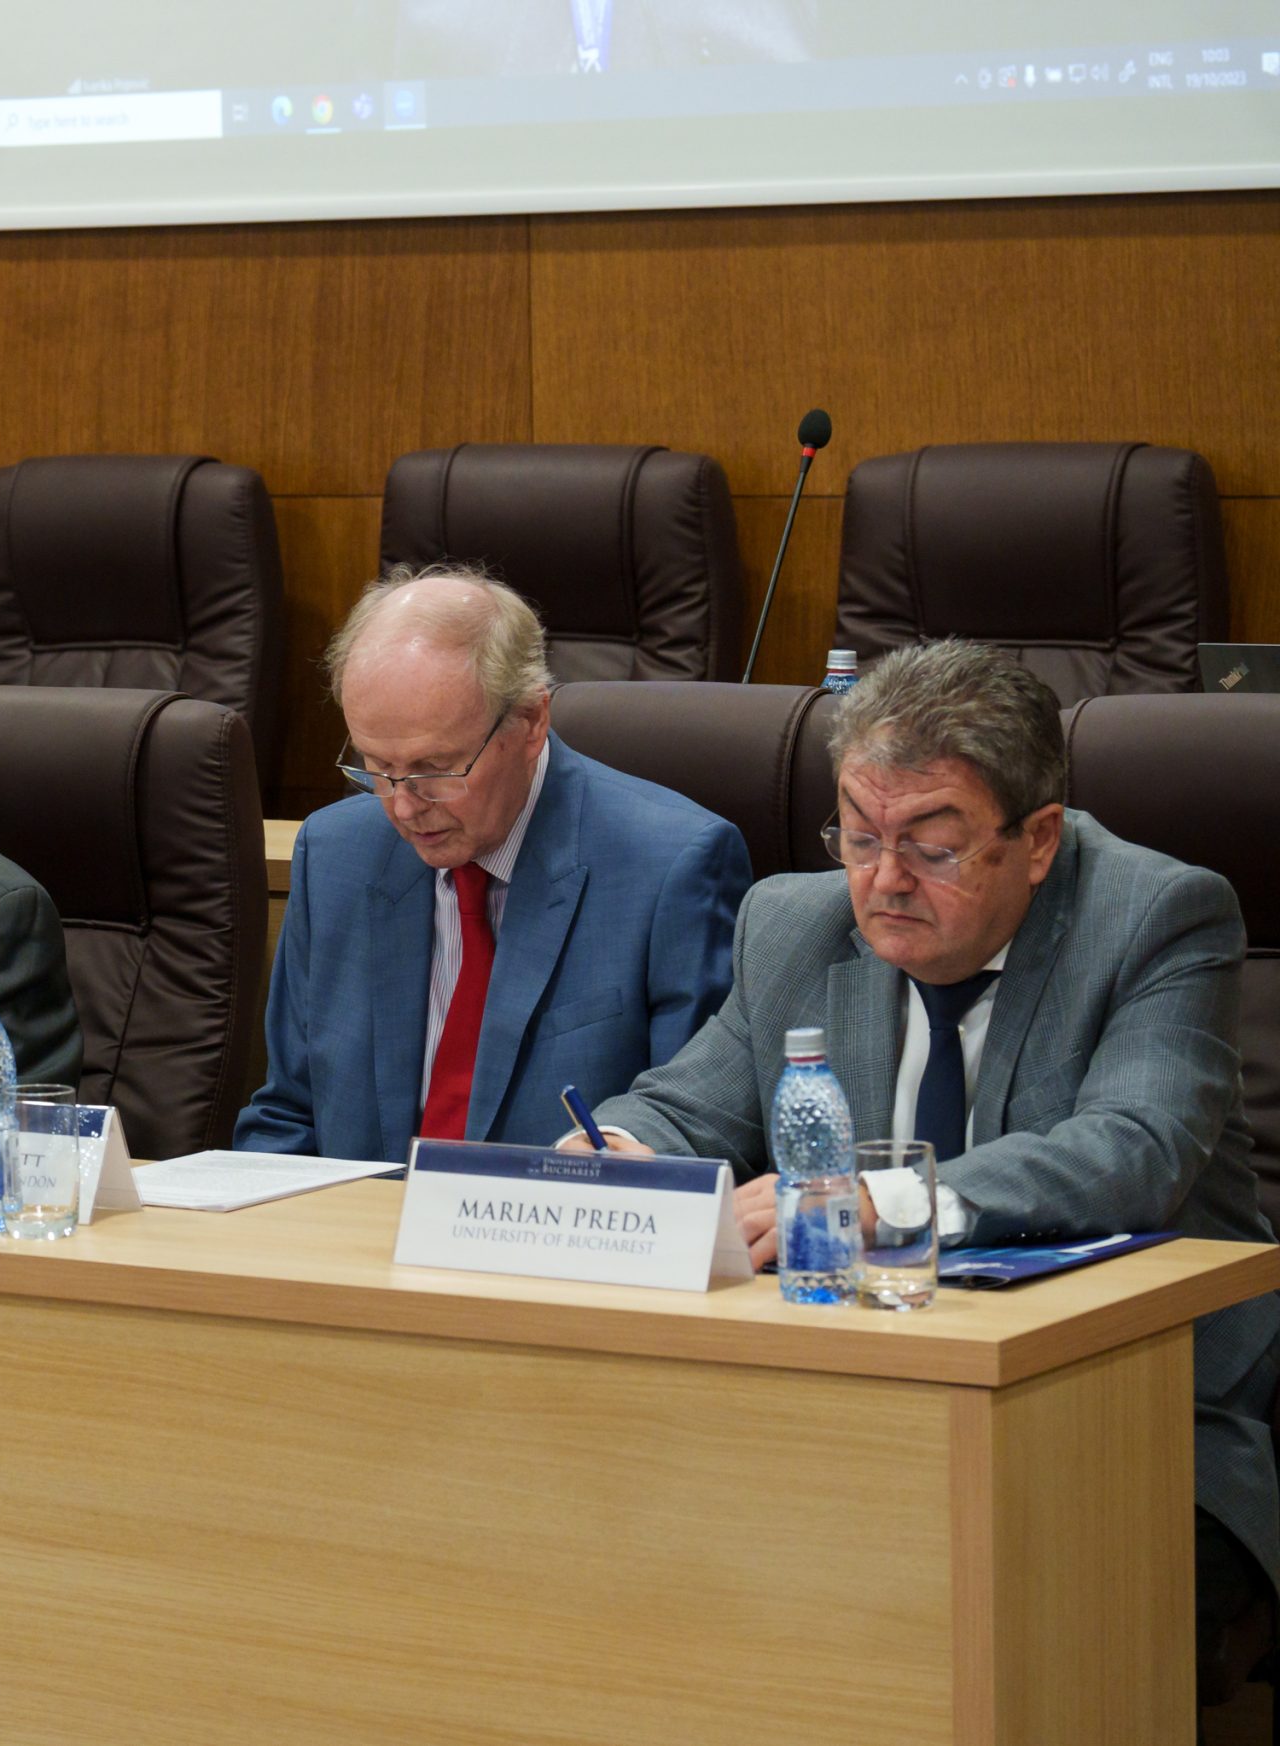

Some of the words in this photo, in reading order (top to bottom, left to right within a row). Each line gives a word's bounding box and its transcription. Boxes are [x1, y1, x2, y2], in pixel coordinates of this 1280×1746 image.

[27, 113, 50, 131] Type
[54, 112, 77, 127] here
[80, 112, 91, 127] to
[95, 111, 130, 126] search
[20, 1152, 46, 1168] TT
[542, 1164, 601, 1177] BUCHAREST
[457, 1199, 562, 1226] MARIAN
[573, 1207, 657, 1235] PREDA
[452, 1225, 539, 1245] UNIVERSITY
[543, 1232, 566, 1247] OF
[568, 1234, 656, 1255] BUCHAREST
